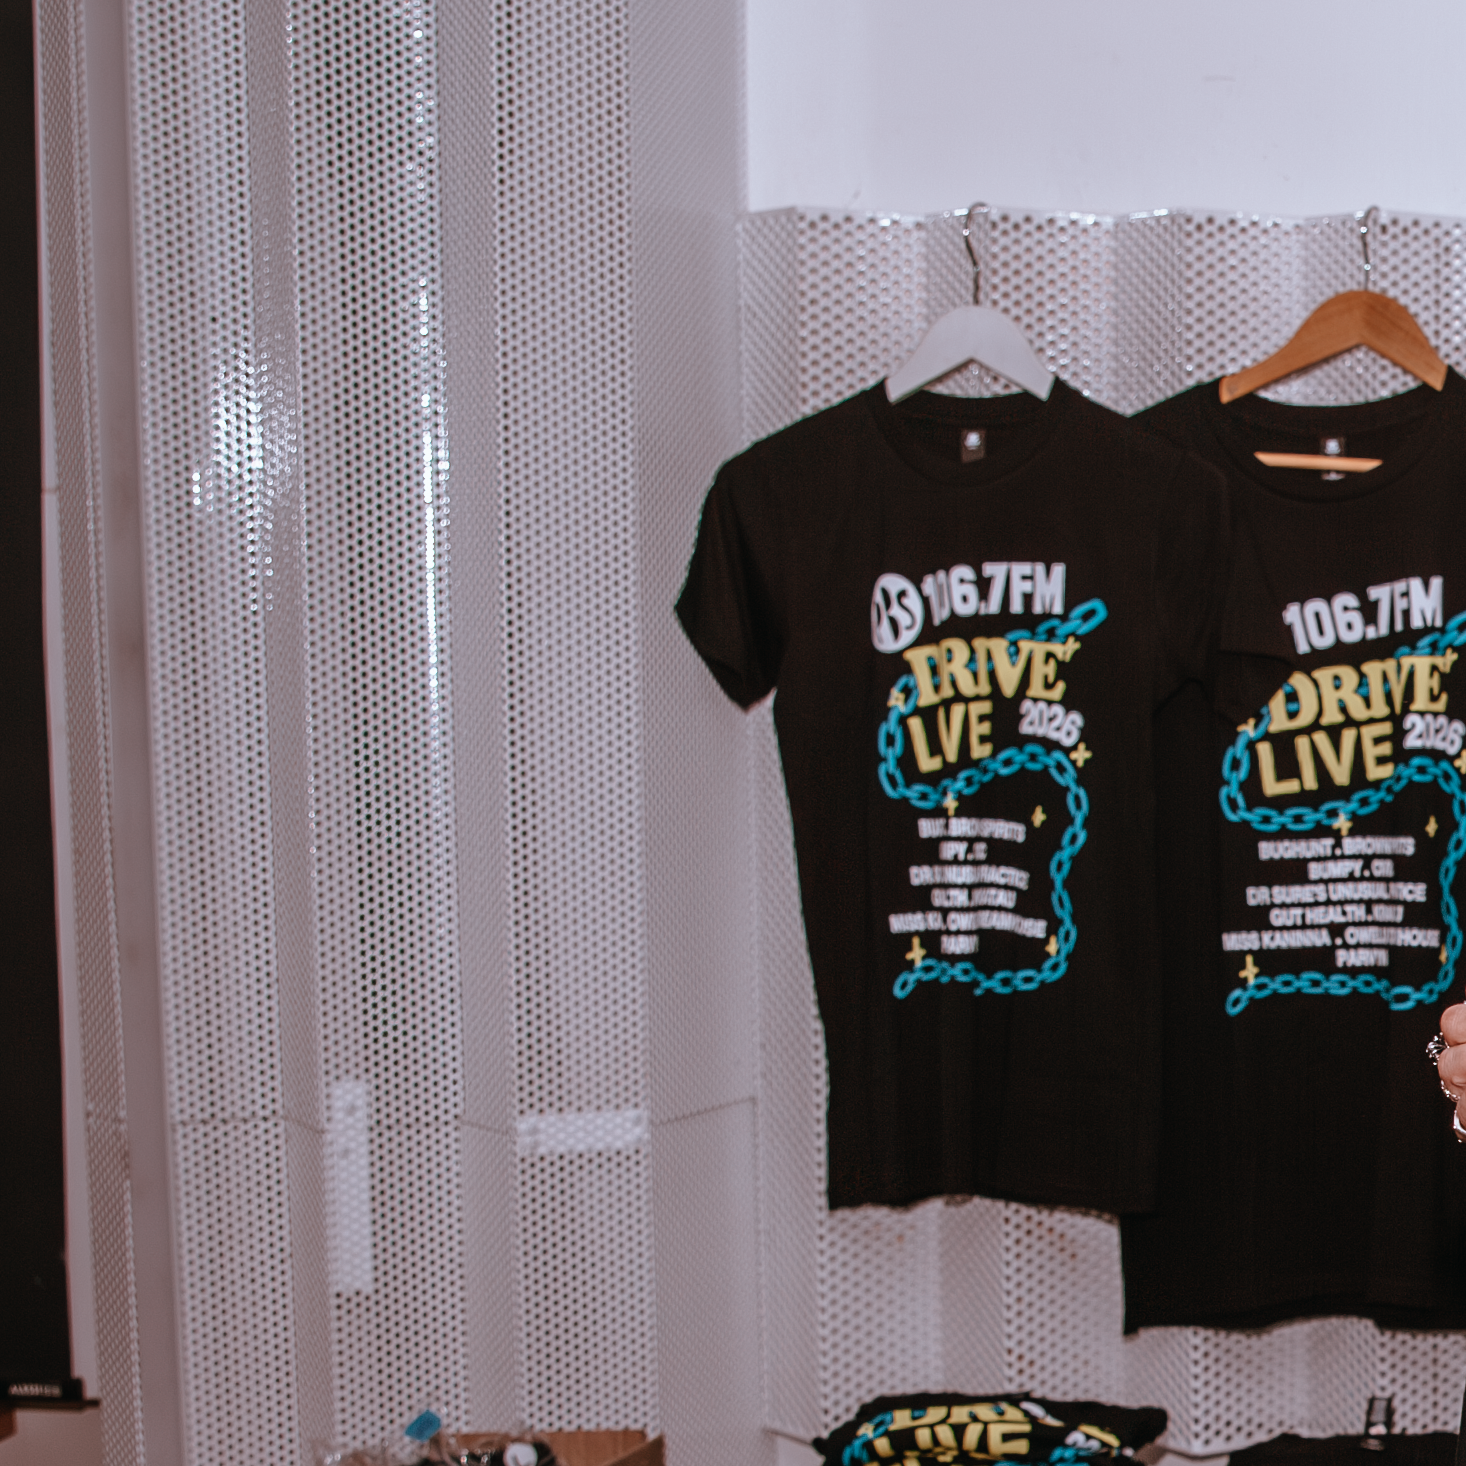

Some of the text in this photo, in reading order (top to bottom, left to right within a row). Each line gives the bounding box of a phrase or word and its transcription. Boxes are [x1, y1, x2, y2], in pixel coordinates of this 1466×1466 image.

[1282, 574, 1445, 655] 106.7FM
[1266, 653, 1449, 733] DRIVE
[1254, 721, 1395, 798] LIVE
